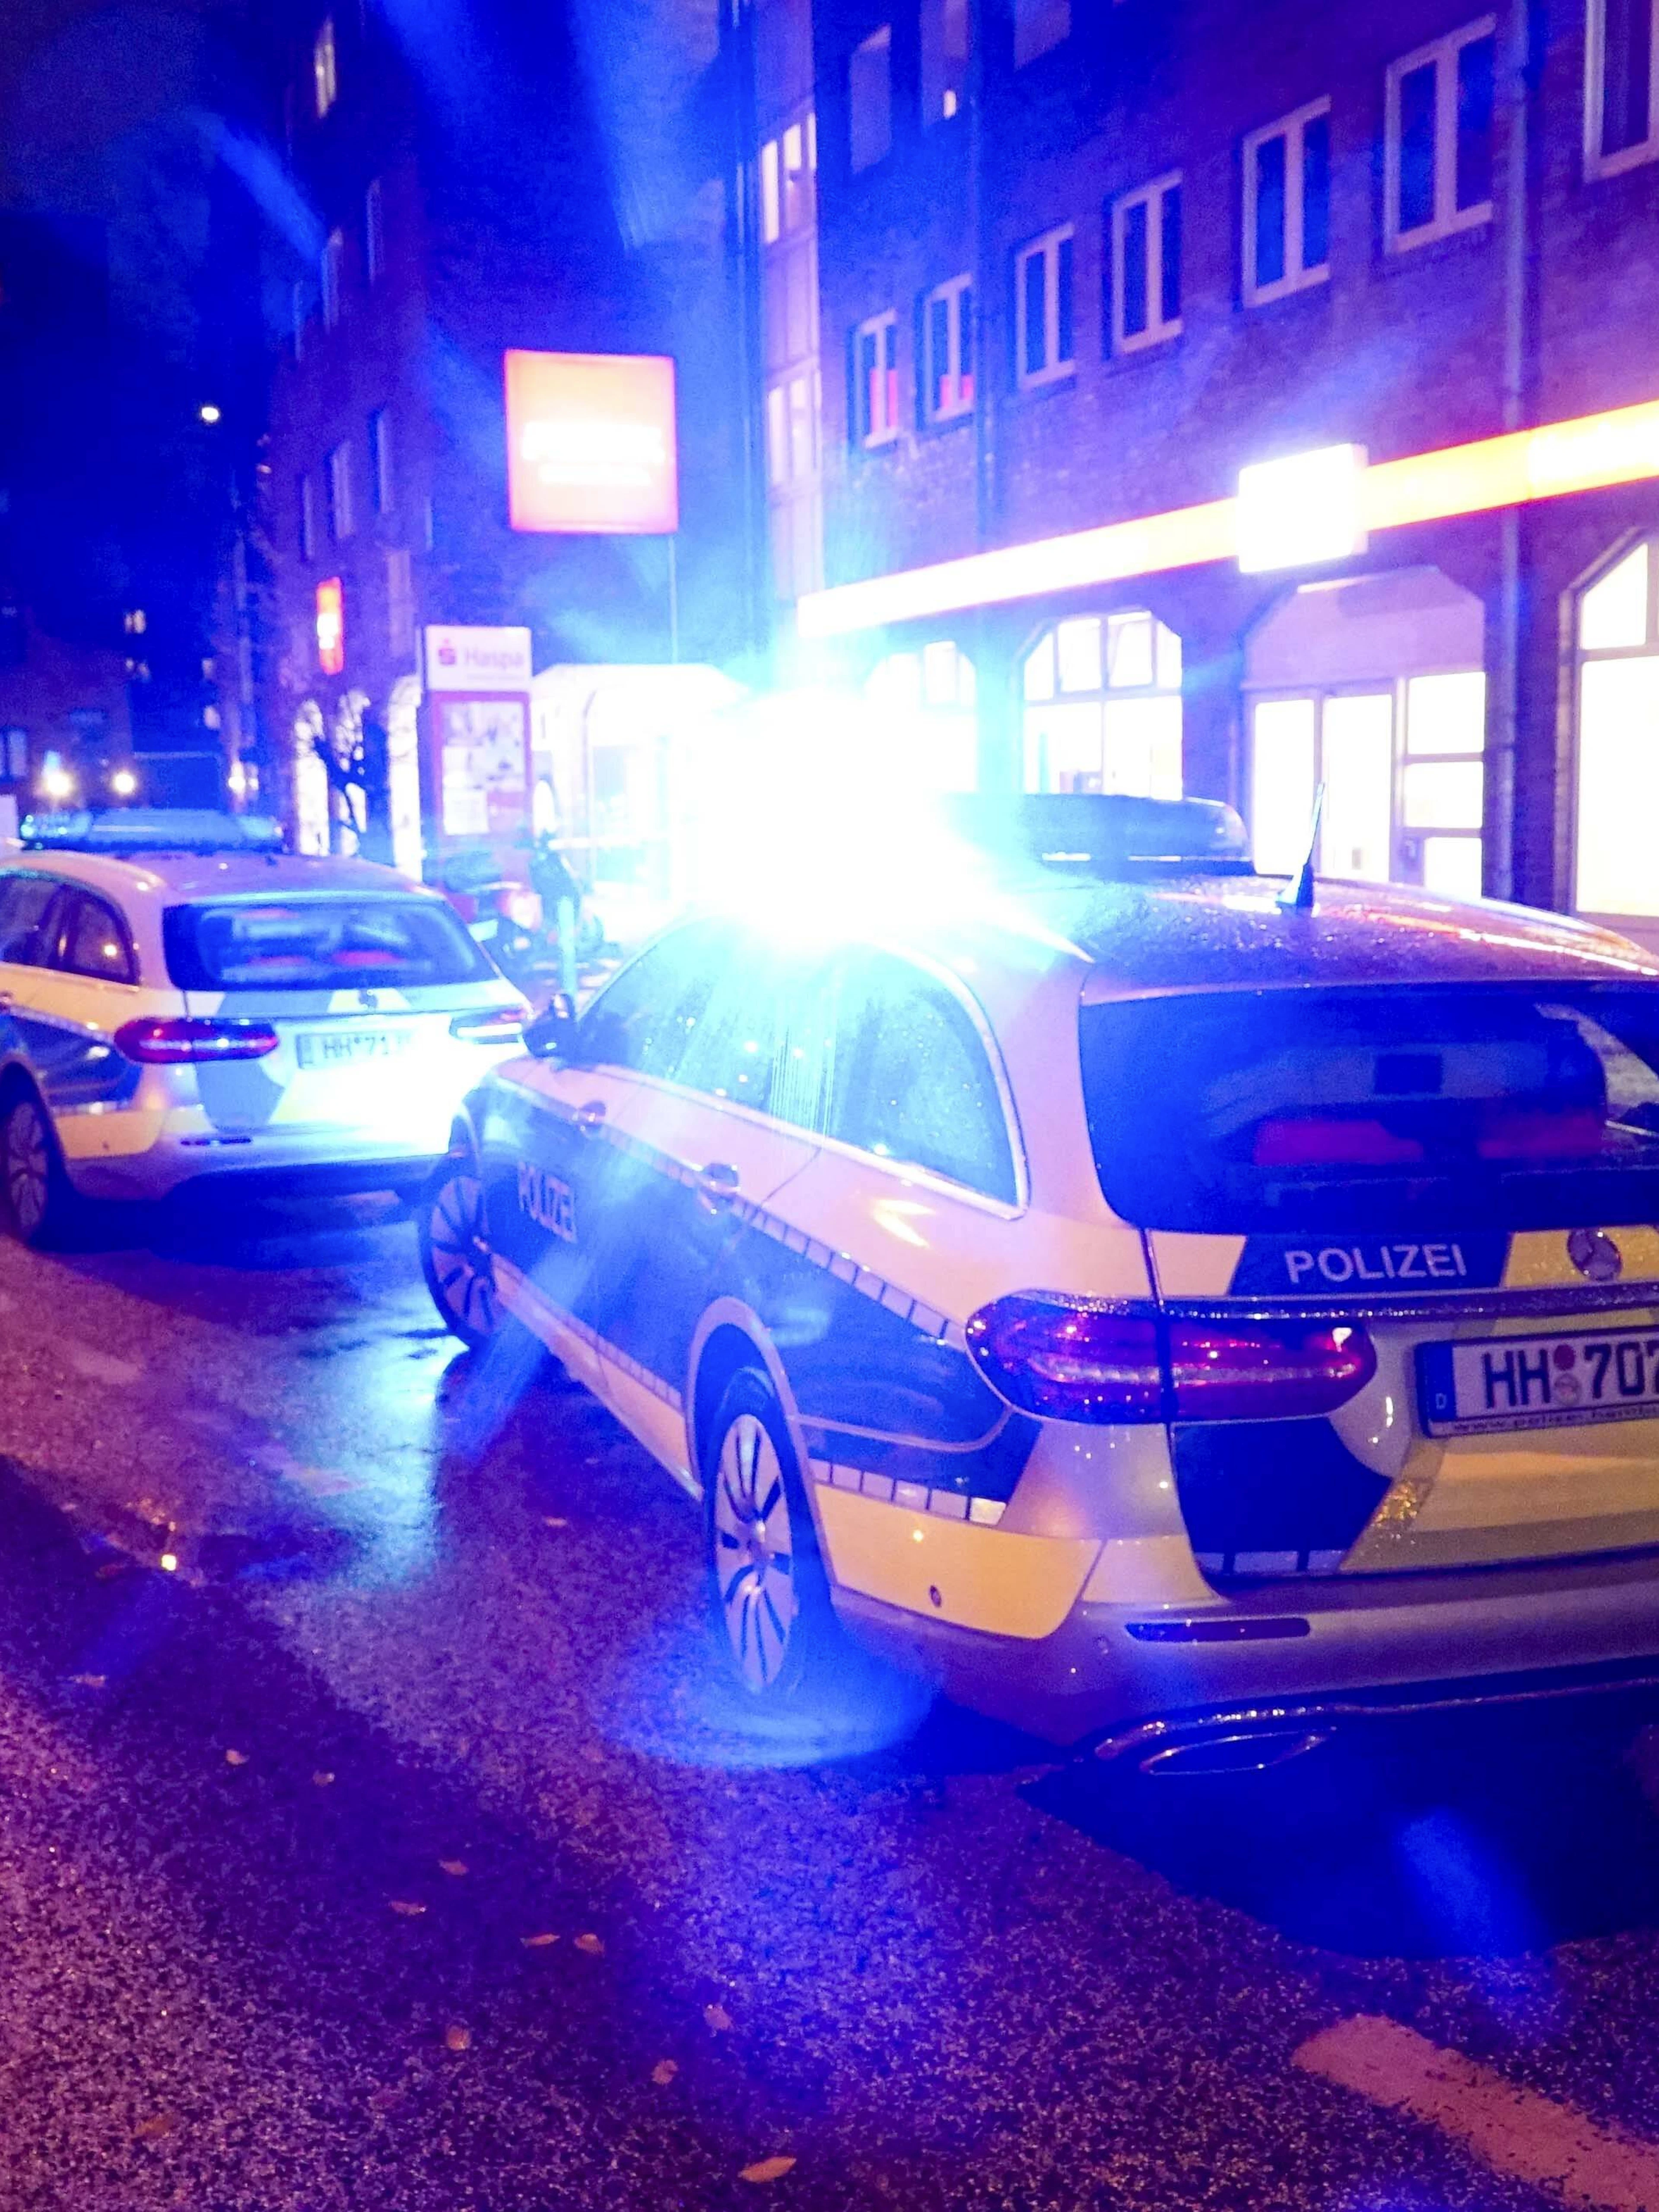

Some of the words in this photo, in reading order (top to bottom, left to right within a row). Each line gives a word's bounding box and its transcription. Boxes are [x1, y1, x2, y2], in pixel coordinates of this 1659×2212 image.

[1285, 1243, 1467, 1284] POLIZEI
[1435, 1392, 1446, 1410] D
[1482, 1348, 1550, 1408] HH
